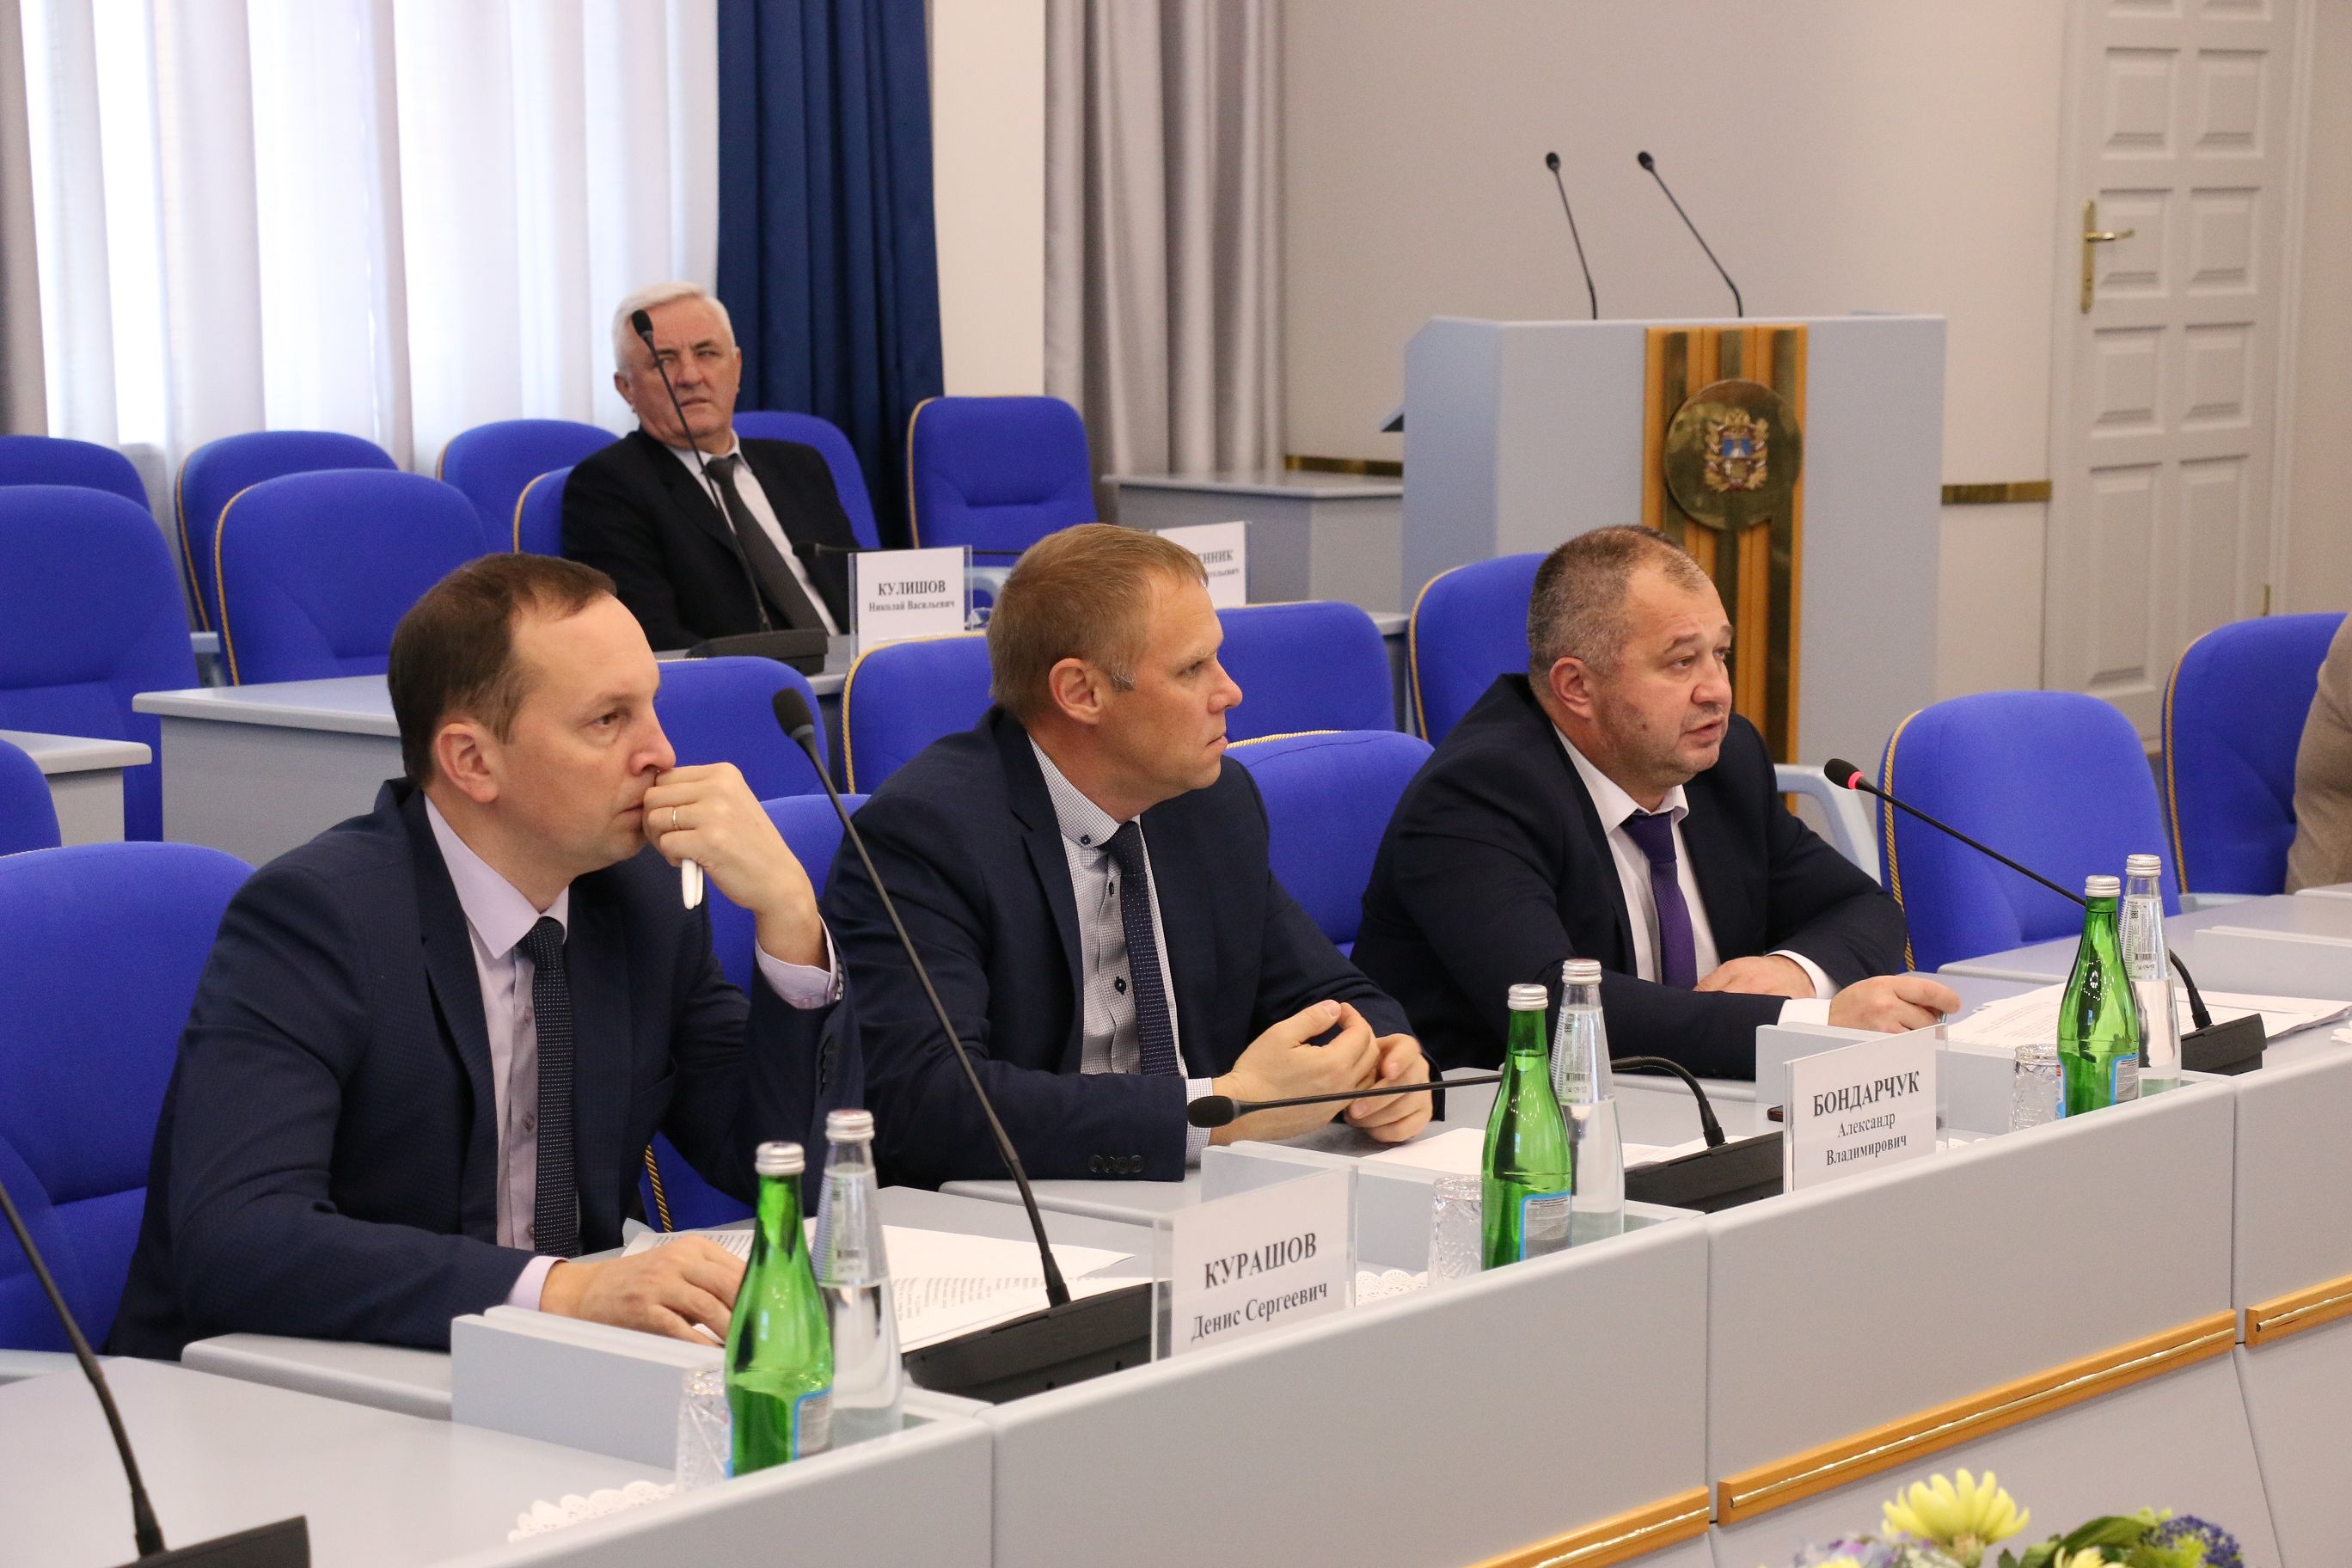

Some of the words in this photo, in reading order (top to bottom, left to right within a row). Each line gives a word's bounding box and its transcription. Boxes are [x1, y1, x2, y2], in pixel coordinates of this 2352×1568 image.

[878, 579, 946, 597] КУЛИШОВ
[868, 601, 905, 613] Николай
[907, 599, 956, 610] Васильевич
[1813, 1070, 1920, 1118] БОНДАРЧУК
[1837, 1112, 1896, 1138] Александр
[1826, 1135, 1908, 1167] Владимирович
[1204, 1232, 1317, 1290] КУРАШОВ
[1190, 1308, 1241, 1343] Денис
[1246, 1282, 1328, 1323] Сергеевич
